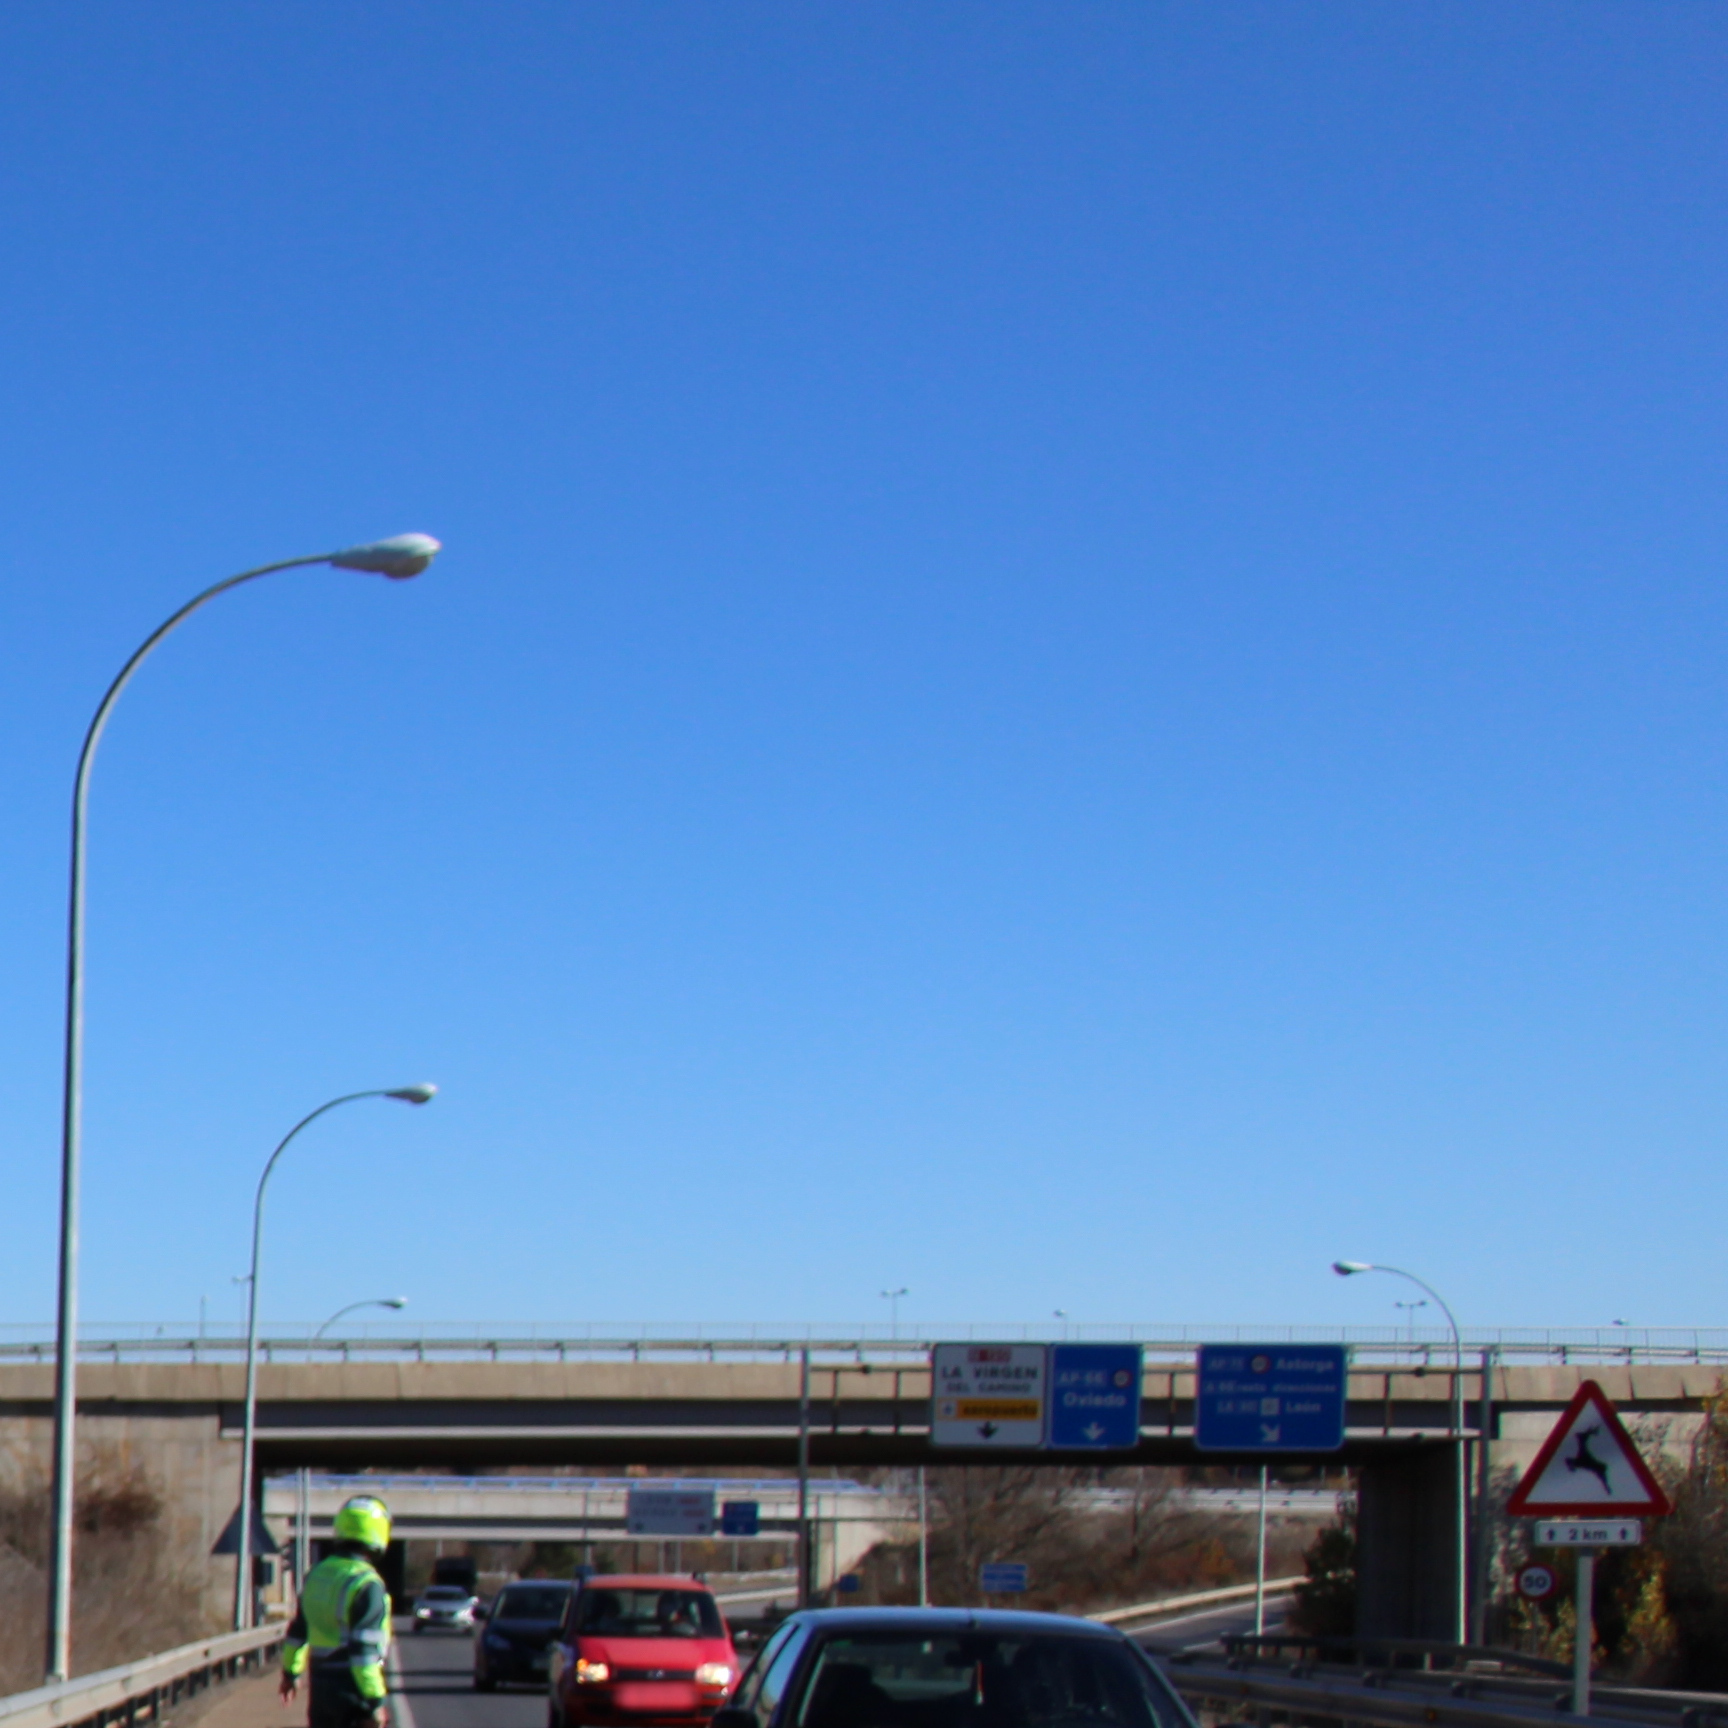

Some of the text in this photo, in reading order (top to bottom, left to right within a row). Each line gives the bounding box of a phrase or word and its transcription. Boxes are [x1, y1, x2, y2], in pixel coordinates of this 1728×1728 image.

[941, 1365, 1039, 1379] LA VIRGEN
[1276, 1357, 1335, 1373] Astorga
[1063, 1391, 1127, 1407] Oviedo
[1568, 1527, 1608, 1541] 2 km
[1524, 1574, 1548, 1589] 50
